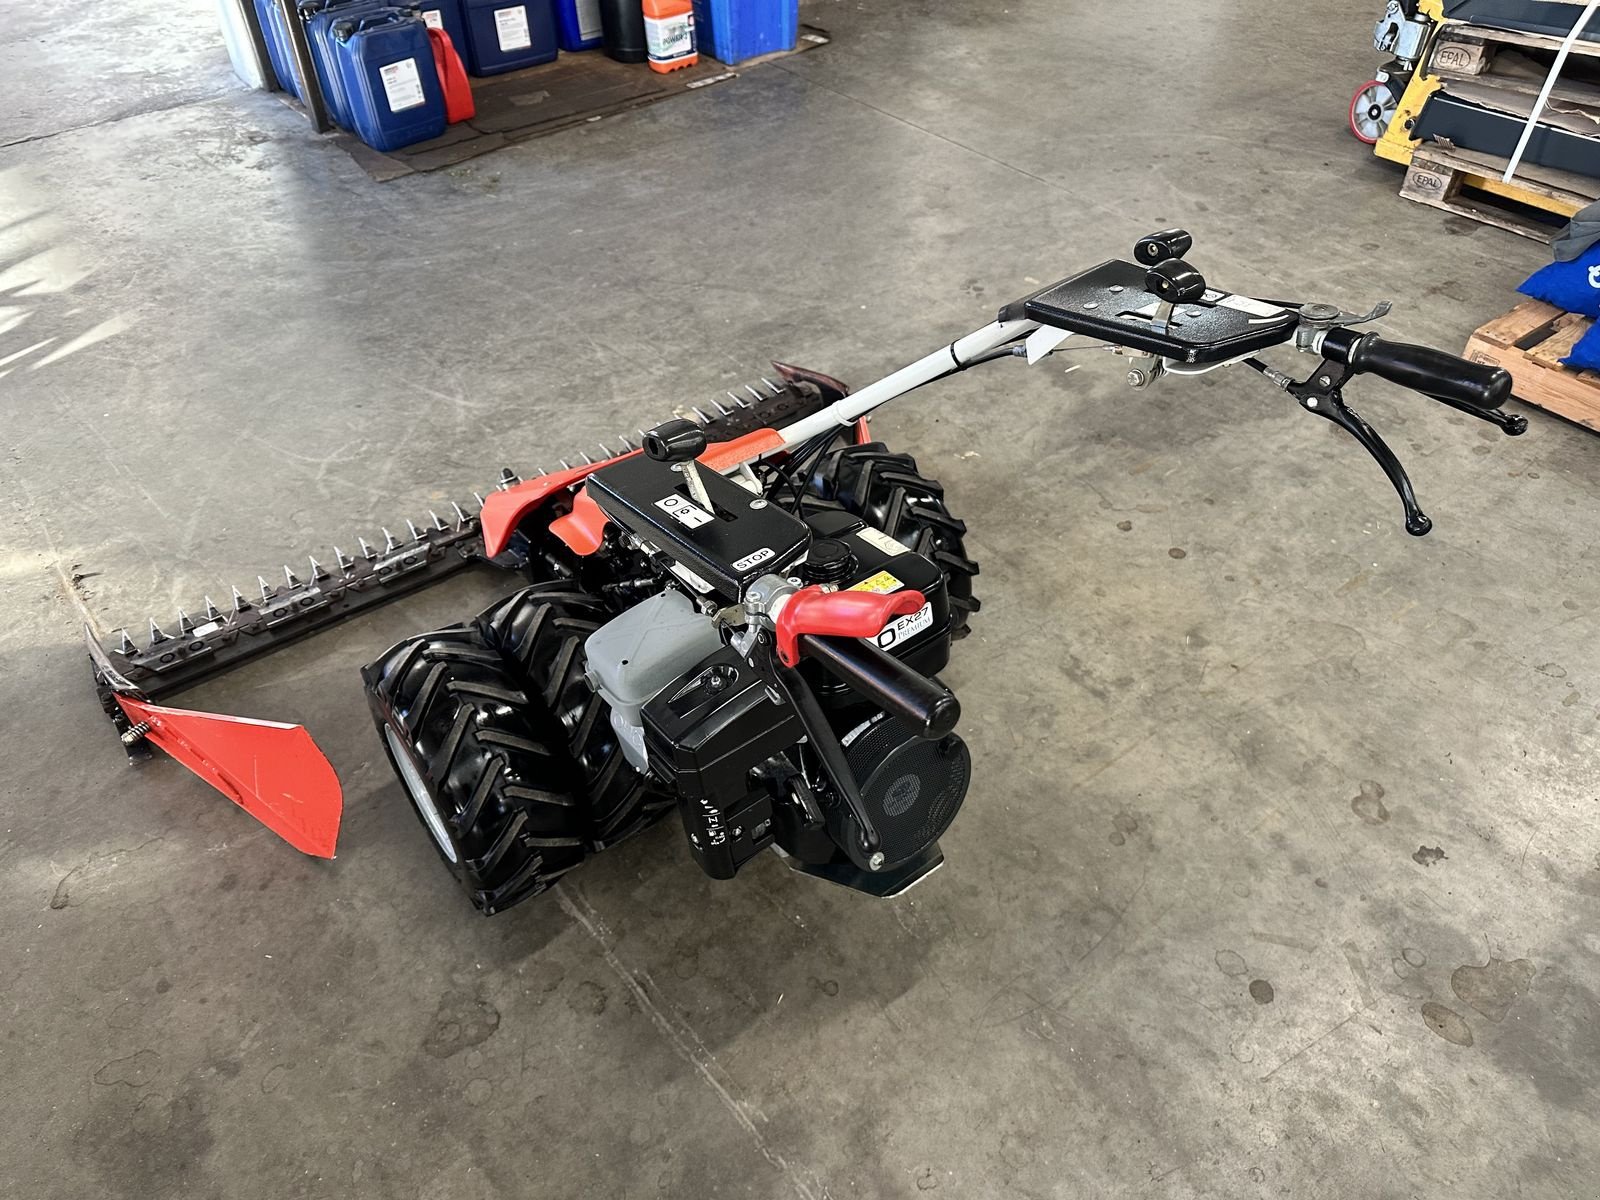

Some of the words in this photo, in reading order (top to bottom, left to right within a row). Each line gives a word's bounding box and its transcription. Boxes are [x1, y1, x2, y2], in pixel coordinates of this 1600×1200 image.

[1440, 50, 1464, 67] EPAL
[1416, 174, 1438, 188] EPAL
[736, 550, 769, 569] STOP
[897, 606, 929, 631] EX27
[897, 616, 931, 640] PREMIUM
